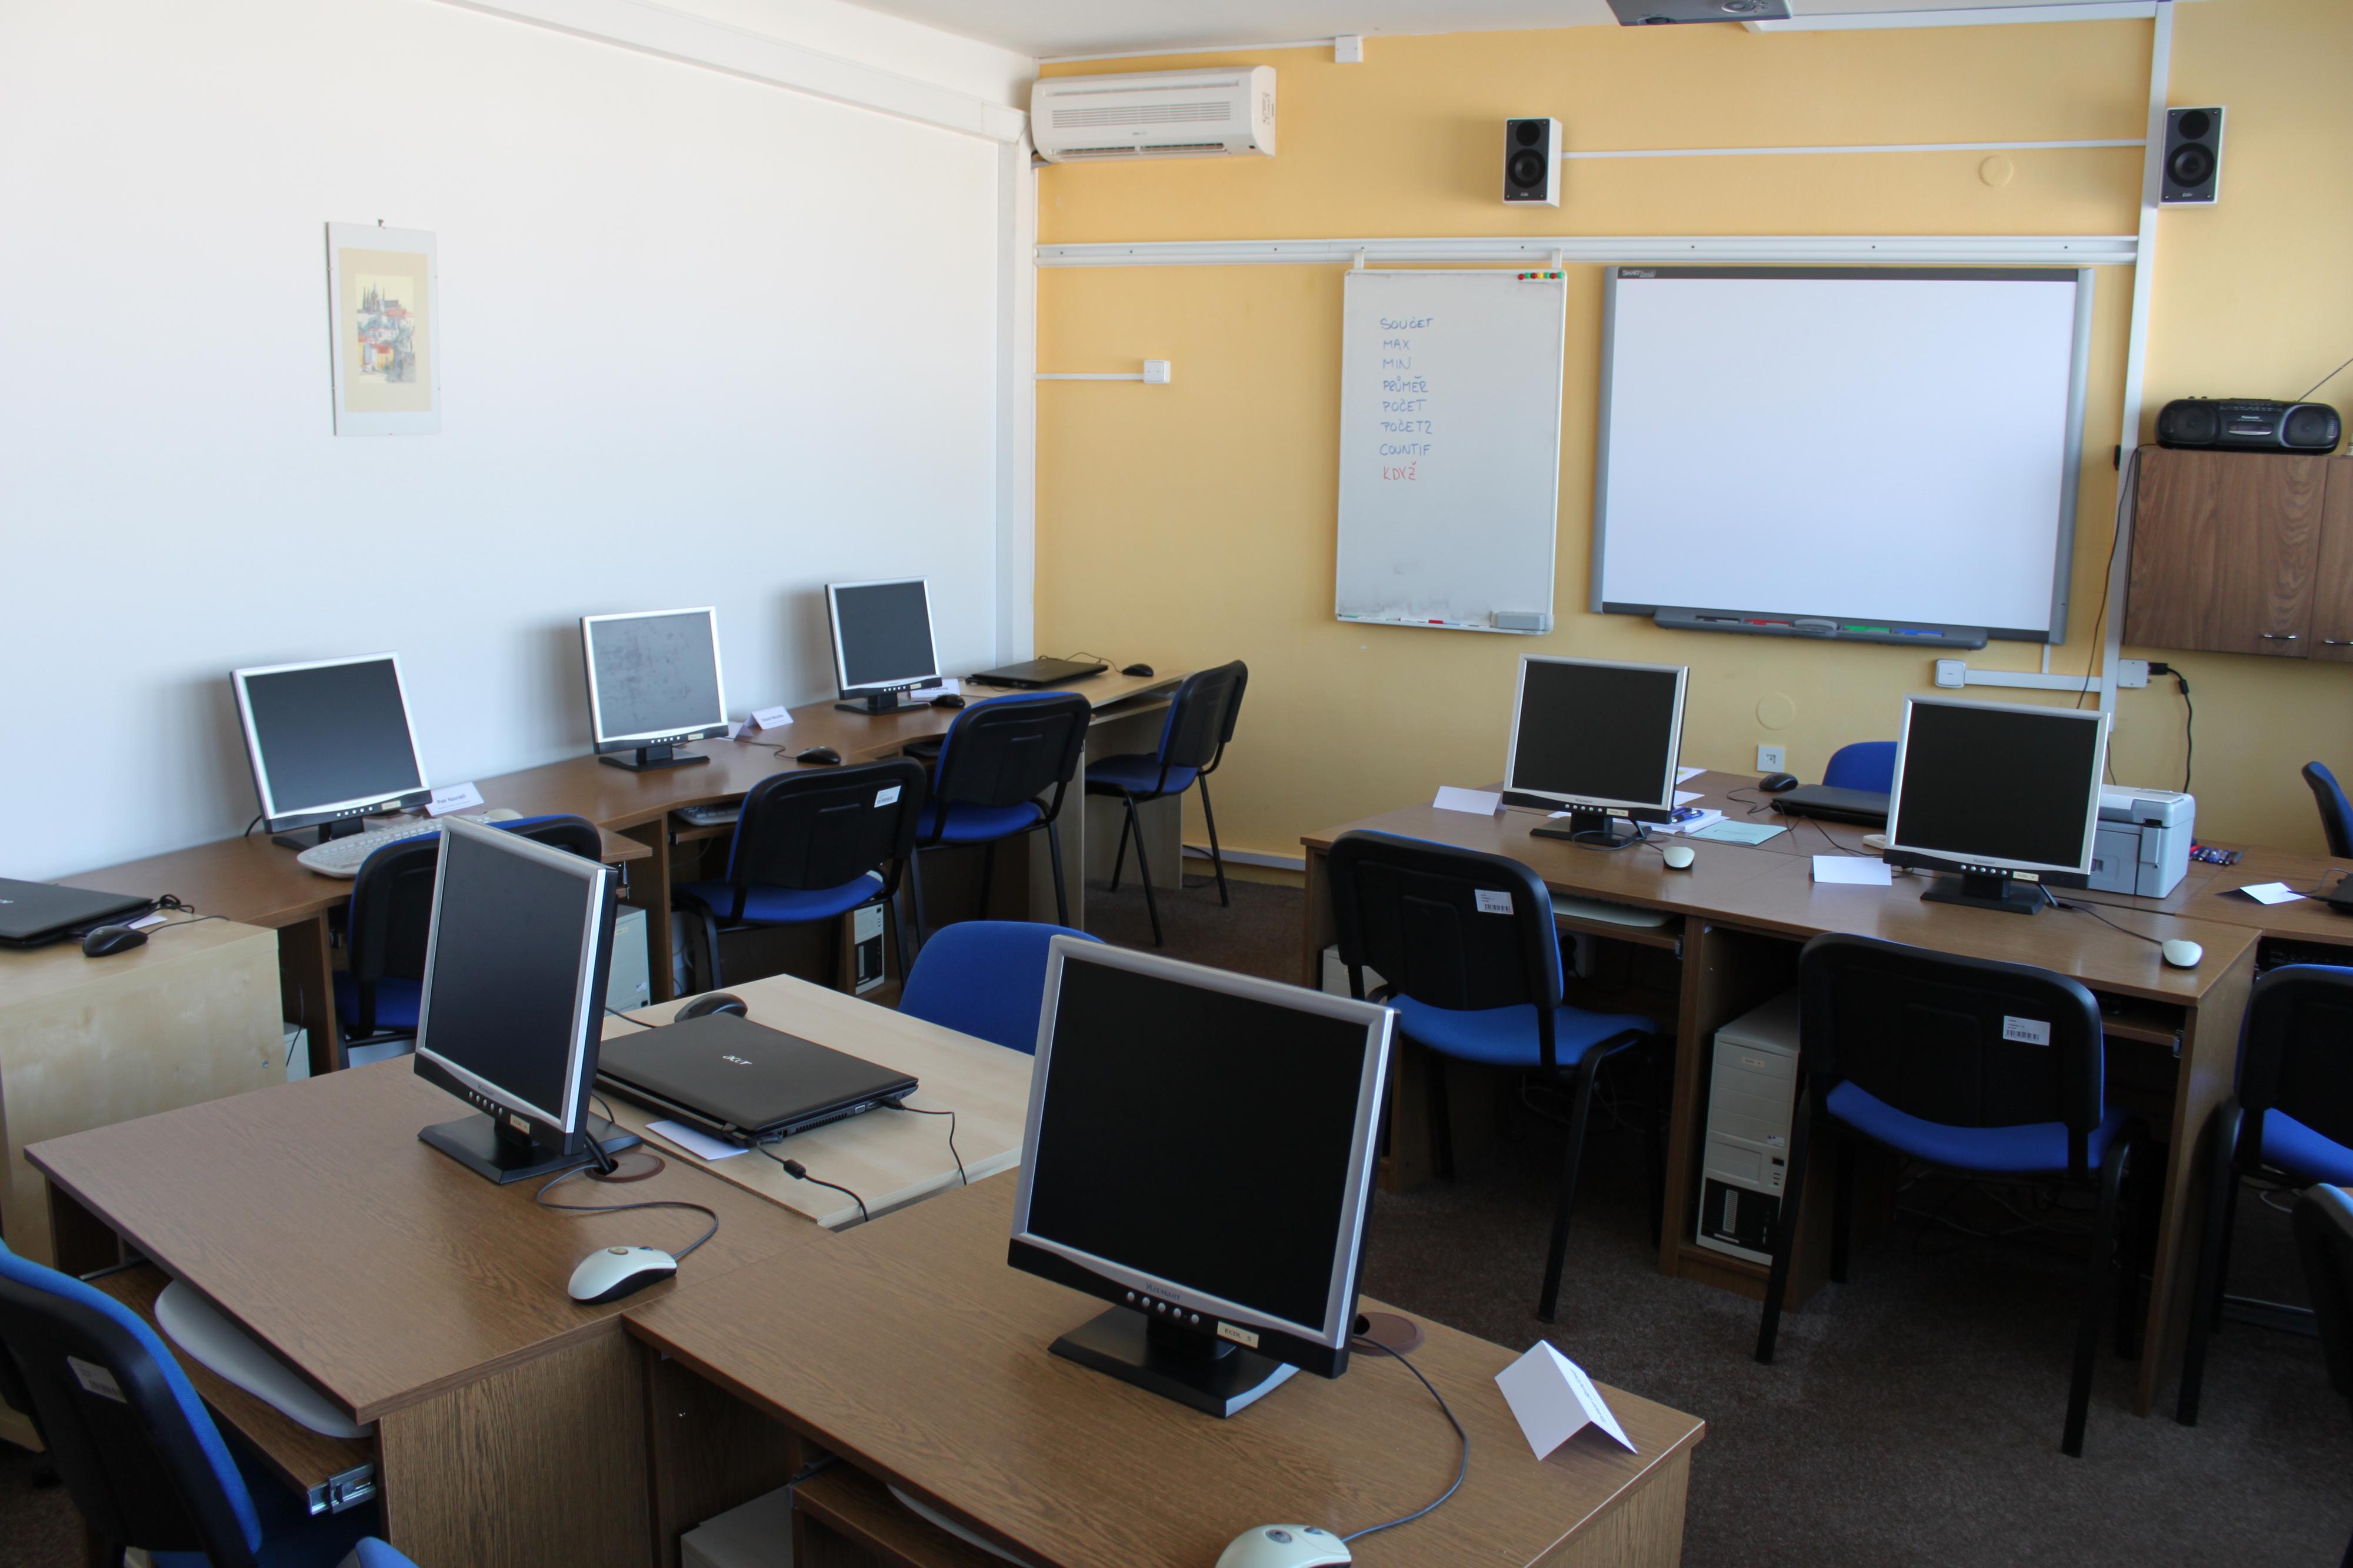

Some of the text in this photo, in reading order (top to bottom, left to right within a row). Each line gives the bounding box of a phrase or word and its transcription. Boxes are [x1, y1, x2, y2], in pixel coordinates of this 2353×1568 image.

[1379, 317, 1434, 330] SOUČET
[1383, 339, 1410, 351] MAX
[1382, 356, 1411, 370] MIN
[1382, 399, 1427, 412] POČET
[1379, 443, 1431, 456] COUNTIF
[1383, 461, 1417, 481] KDYŽ
[722, 1055, 753, 1065] acer
[1224, 1328, 1242, 1339] ECDL
